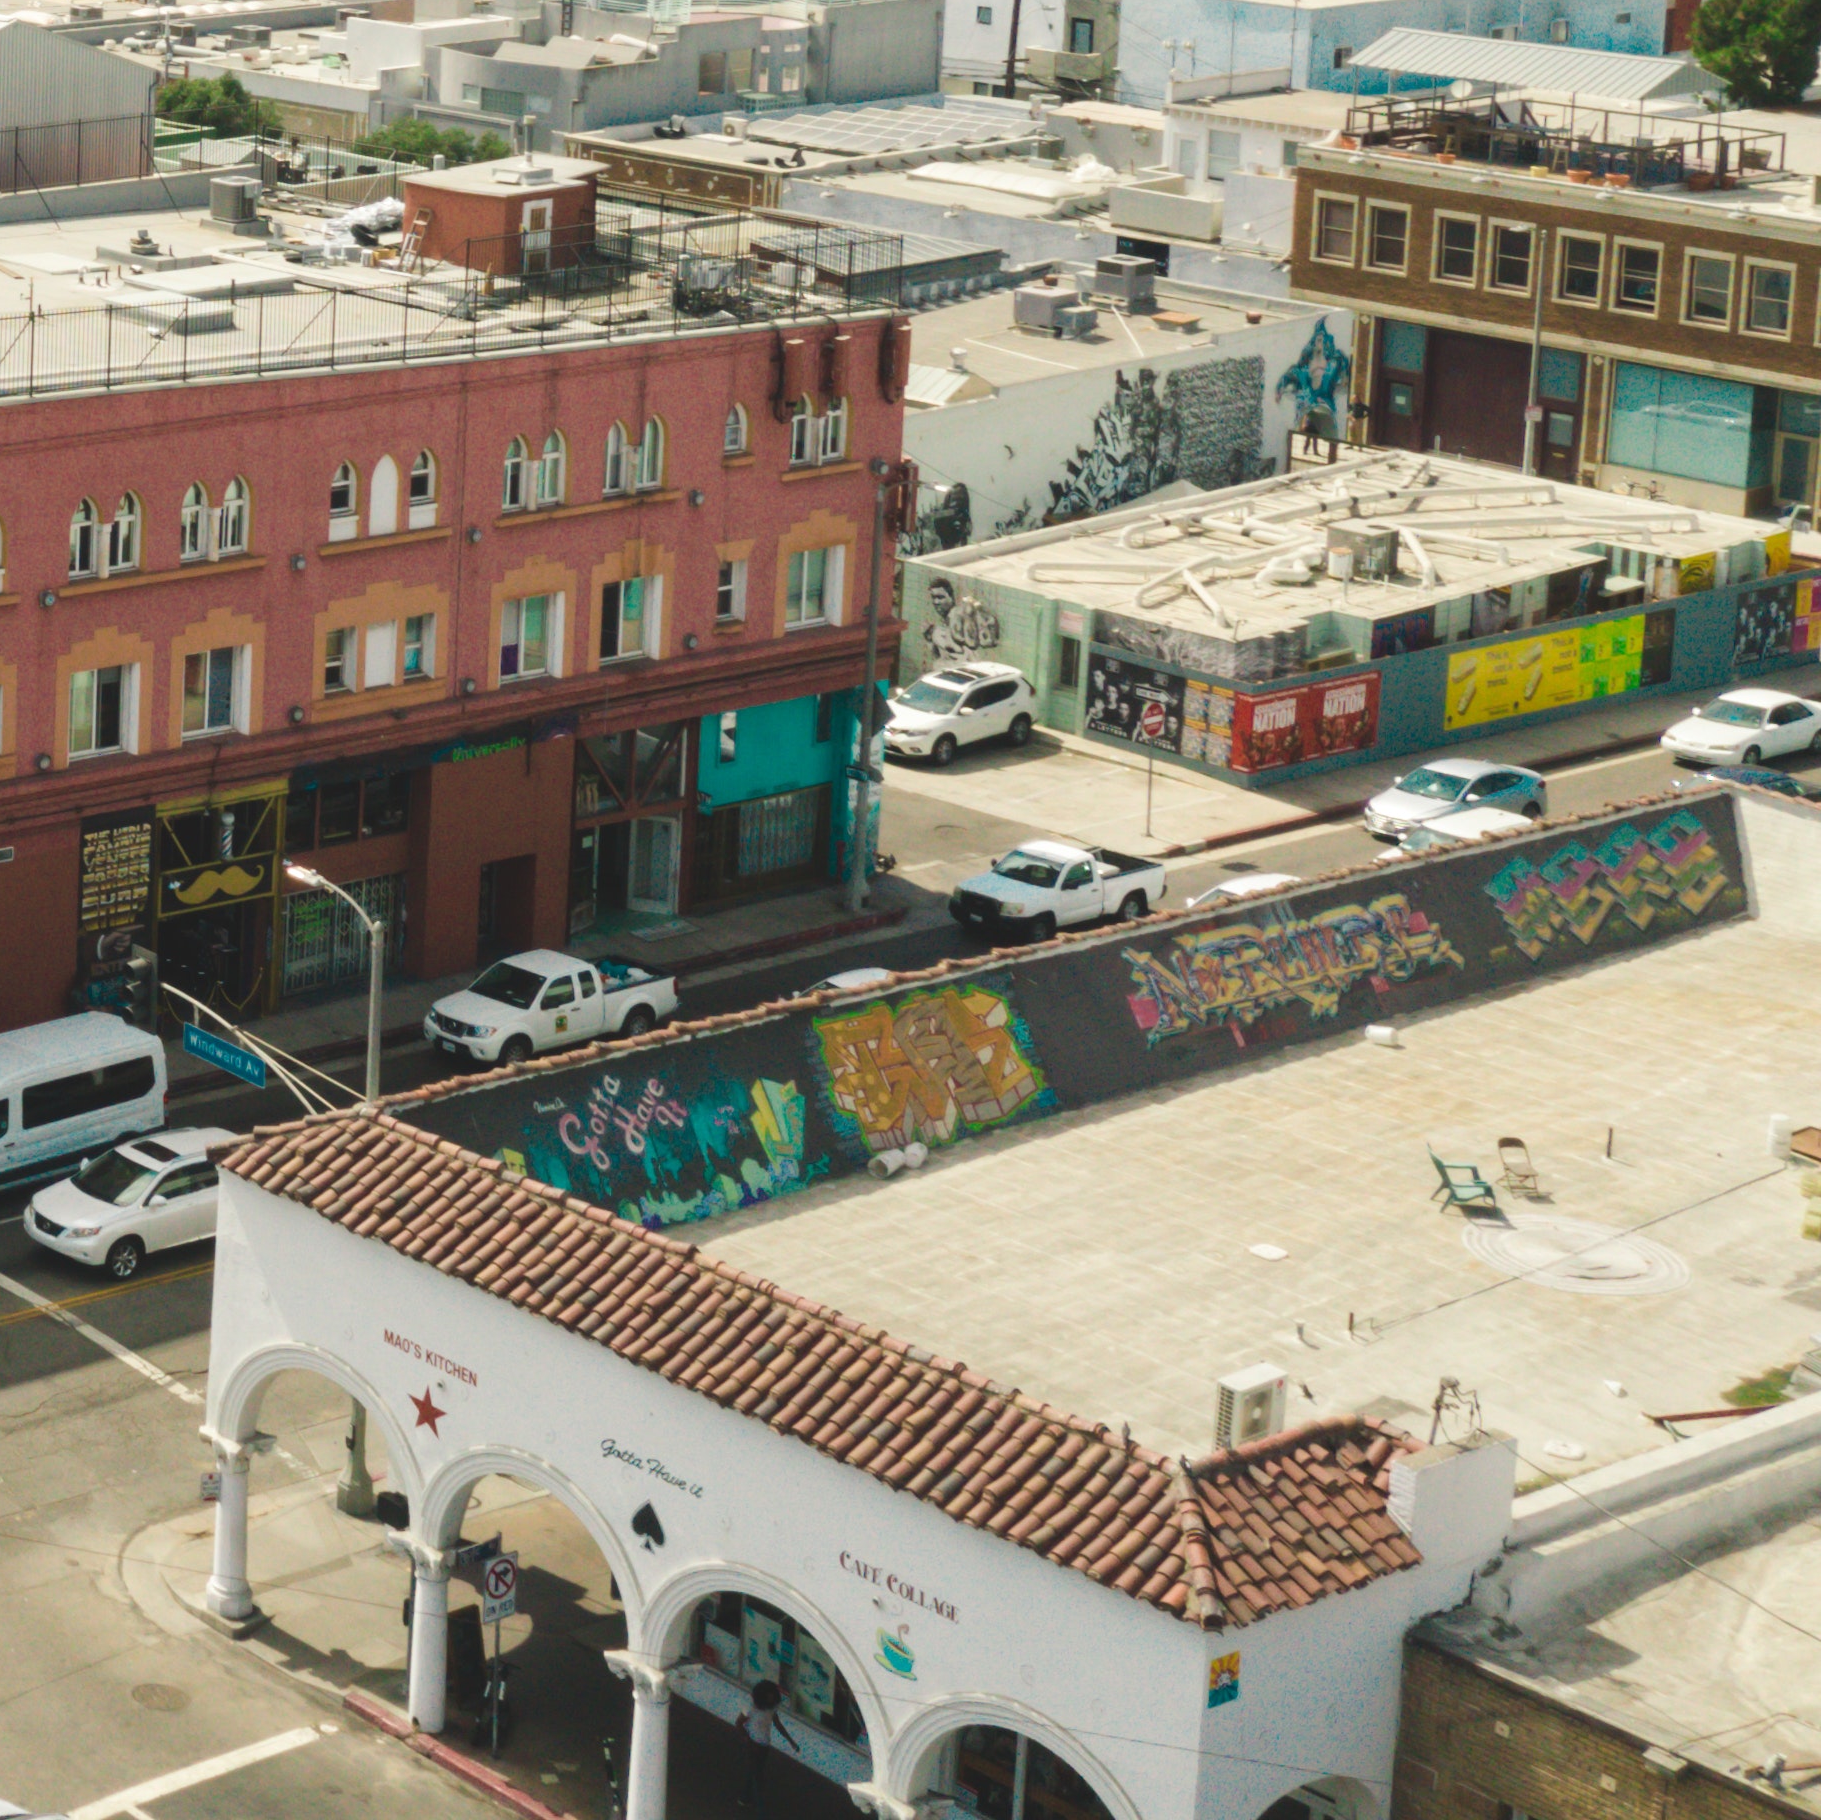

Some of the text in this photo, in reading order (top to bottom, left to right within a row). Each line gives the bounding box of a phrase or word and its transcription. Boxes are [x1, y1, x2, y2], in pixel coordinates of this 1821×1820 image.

[189, 1032, 260, 1077] Windward Av
[384, 1329, 478, 1387] MAO'S KITCHEN
[601, 1438, 644, 1471] Gotta
[646, 1457, 688, 1492] Have
[839, 1550, 960, 1624] CAFE COLLAGE
